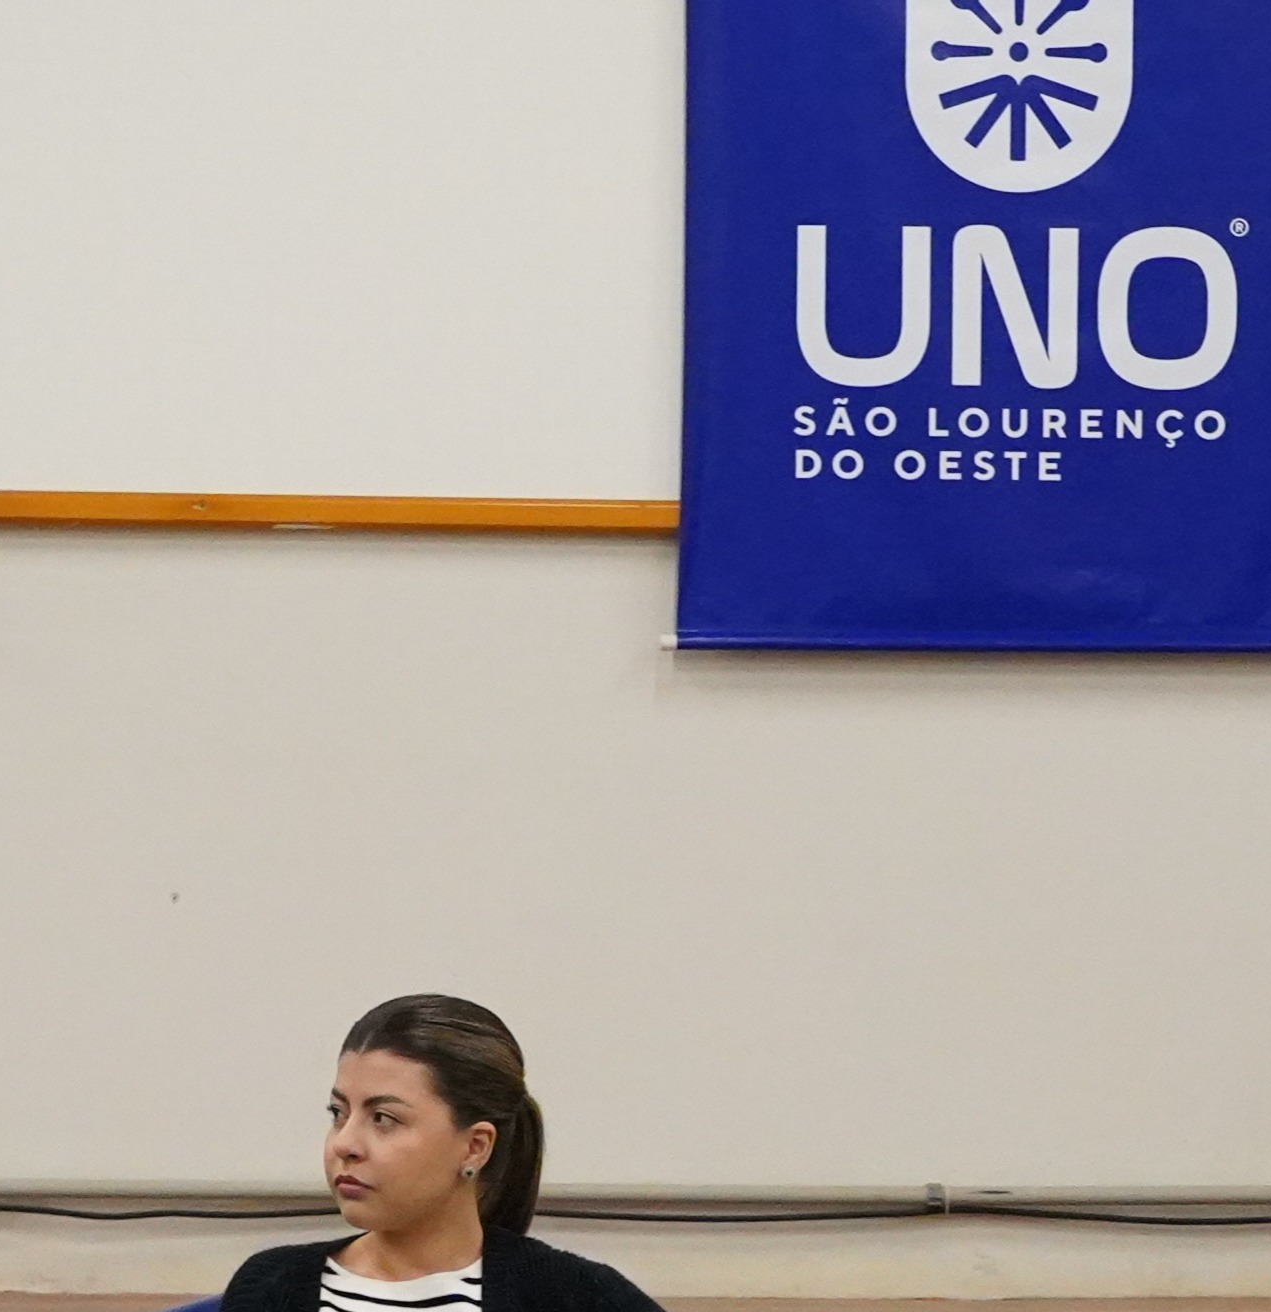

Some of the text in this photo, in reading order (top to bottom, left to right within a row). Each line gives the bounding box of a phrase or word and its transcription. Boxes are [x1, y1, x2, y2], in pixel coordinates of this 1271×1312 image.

[796, 224, 1238, 389] UNO
[794, 398, 1227, 449] SÃO LOURENÇO
[794, 449, 1062, 481] DO OESTE
